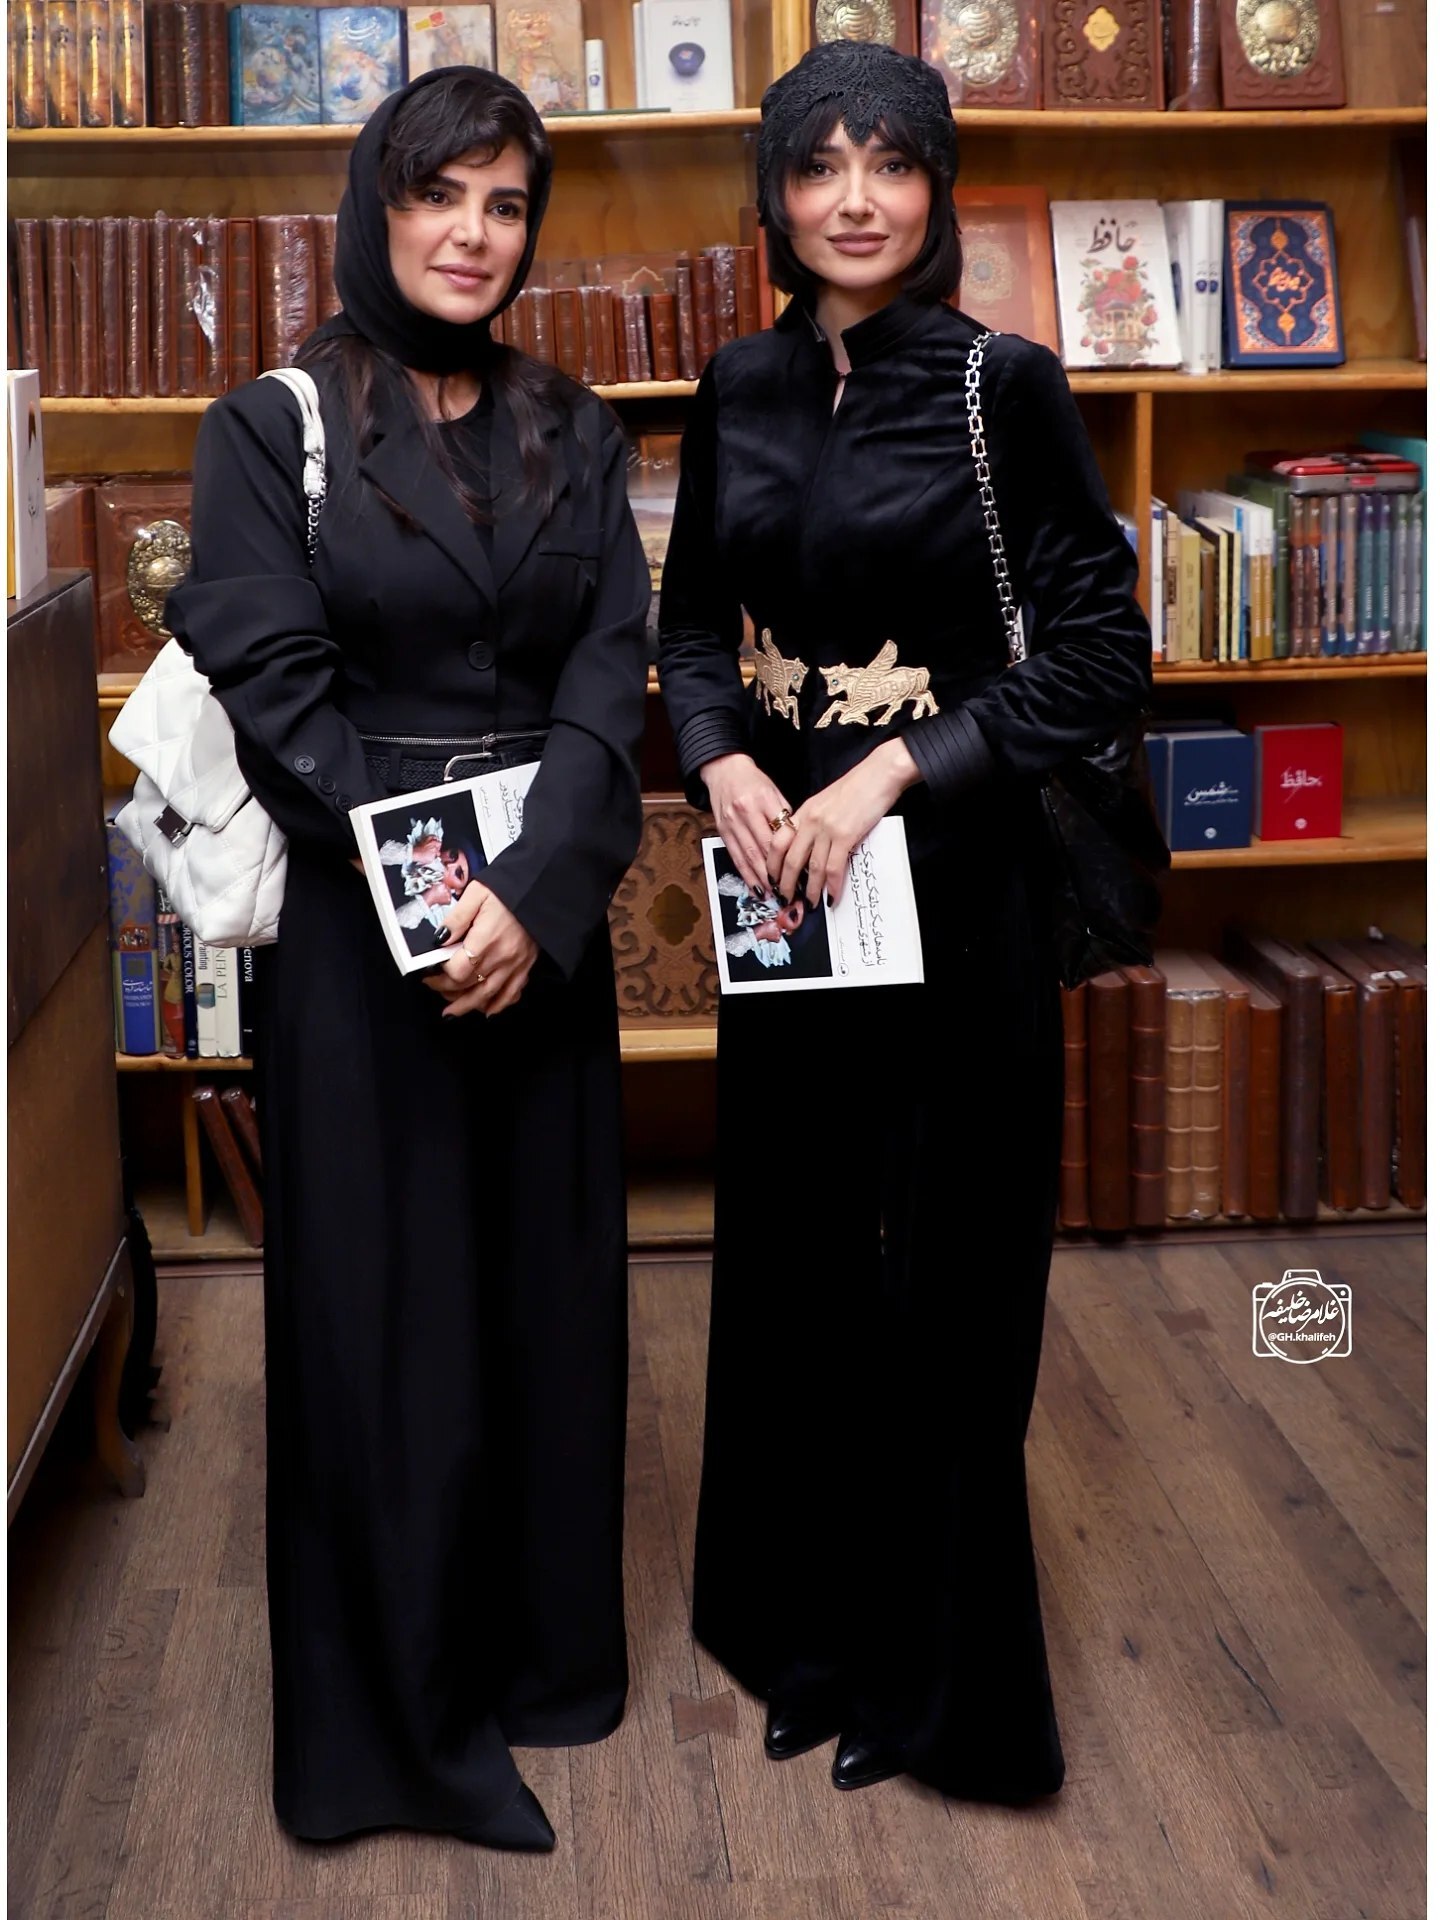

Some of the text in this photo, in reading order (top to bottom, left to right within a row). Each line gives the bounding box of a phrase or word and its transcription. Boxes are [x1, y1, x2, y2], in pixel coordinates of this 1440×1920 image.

[1086, 216, 1136, 254] حافظ
[860, 843, 877, 881] کوچک
[865, 879, 880, 908] دلقک
[854, 901, 869, 930] بسیار
[869, 909, 884, 928] یک
[857, 929, 871, 957] شهری
[183, 960, 195, 994] COLOR
[242, 945, 254, 983] enova
[216, 982, 228, 999] LA
